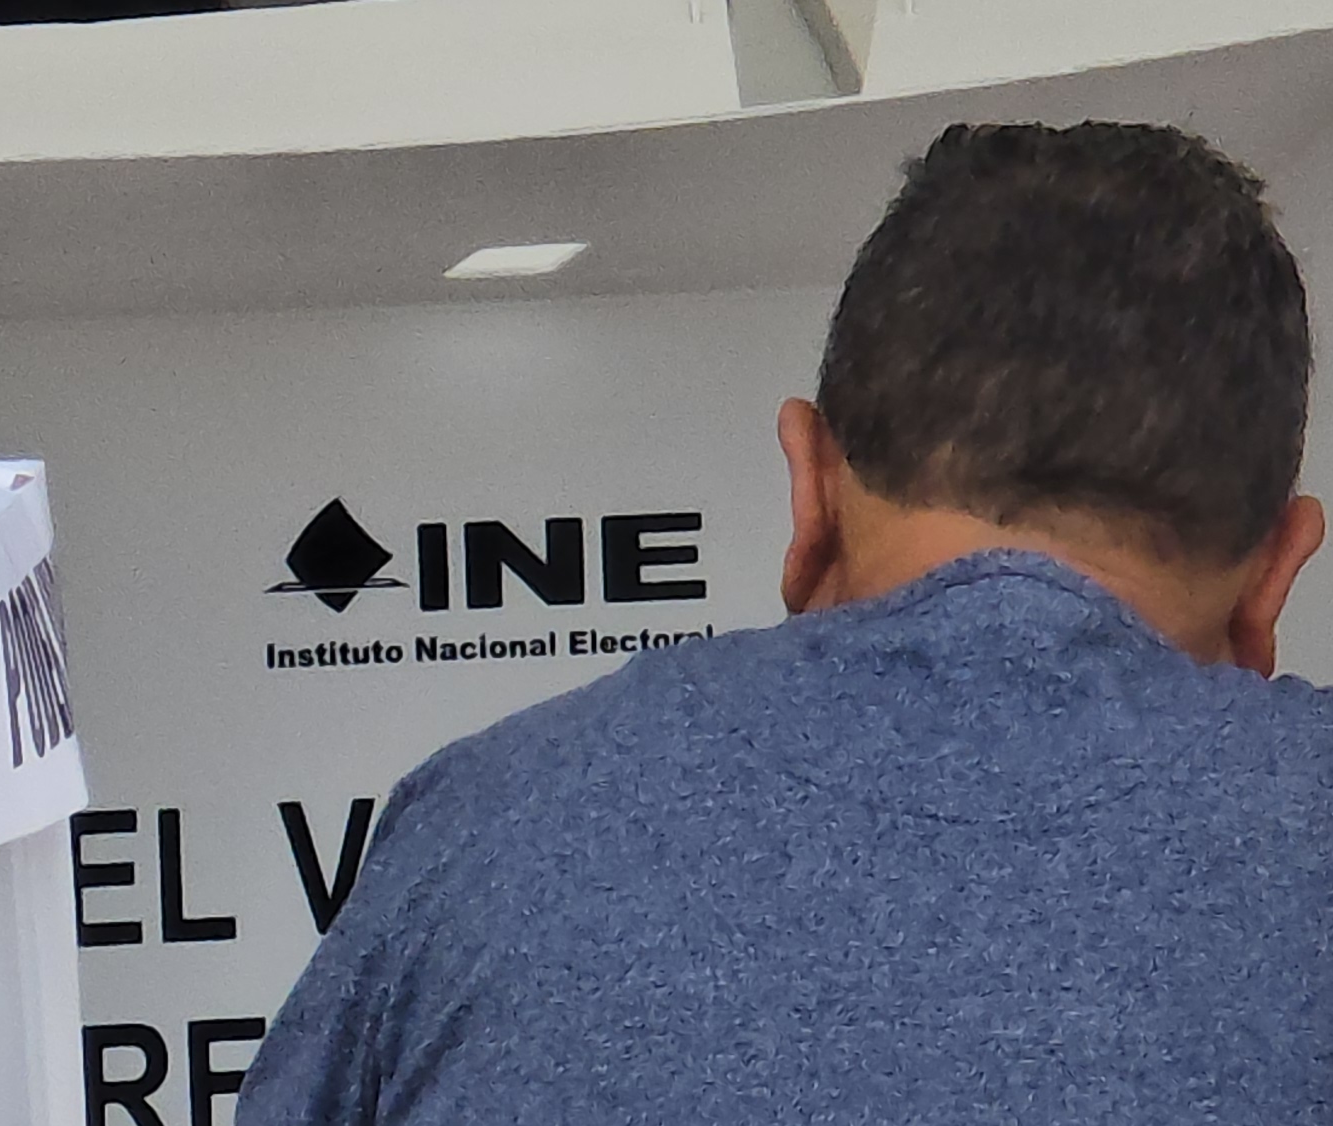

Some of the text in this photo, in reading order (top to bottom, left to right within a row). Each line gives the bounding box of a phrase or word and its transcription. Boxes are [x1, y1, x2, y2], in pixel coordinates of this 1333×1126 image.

[416, 512, 707, 612] INE
[265, 640, 404, 670] Instituto
[415, 630, 556, 663] Nacional
[69, 808, 237, 948] EL
